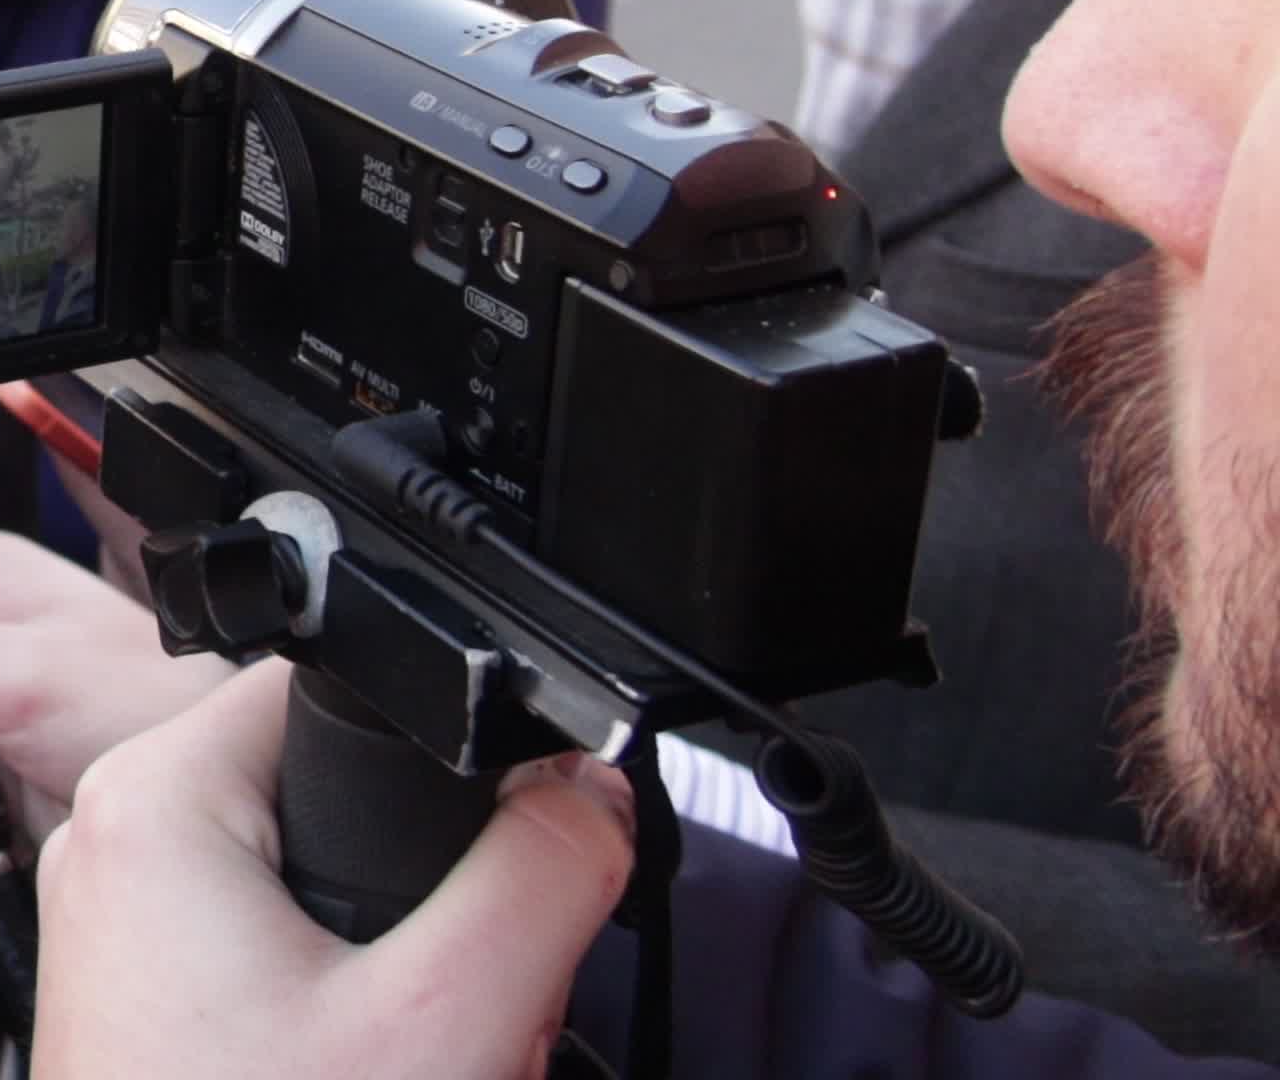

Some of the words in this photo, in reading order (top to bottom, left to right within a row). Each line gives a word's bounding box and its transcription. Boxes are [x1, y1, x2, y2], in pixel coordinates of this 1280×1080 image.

[362, 153, 393, 181] SHOE
[360, 187, 408, 224] RELEASE
[361, 172, 412, 208] ADAPTOR
[368, 367, 400, 401] MULTI
[494, 473, 527, 503] BATT
